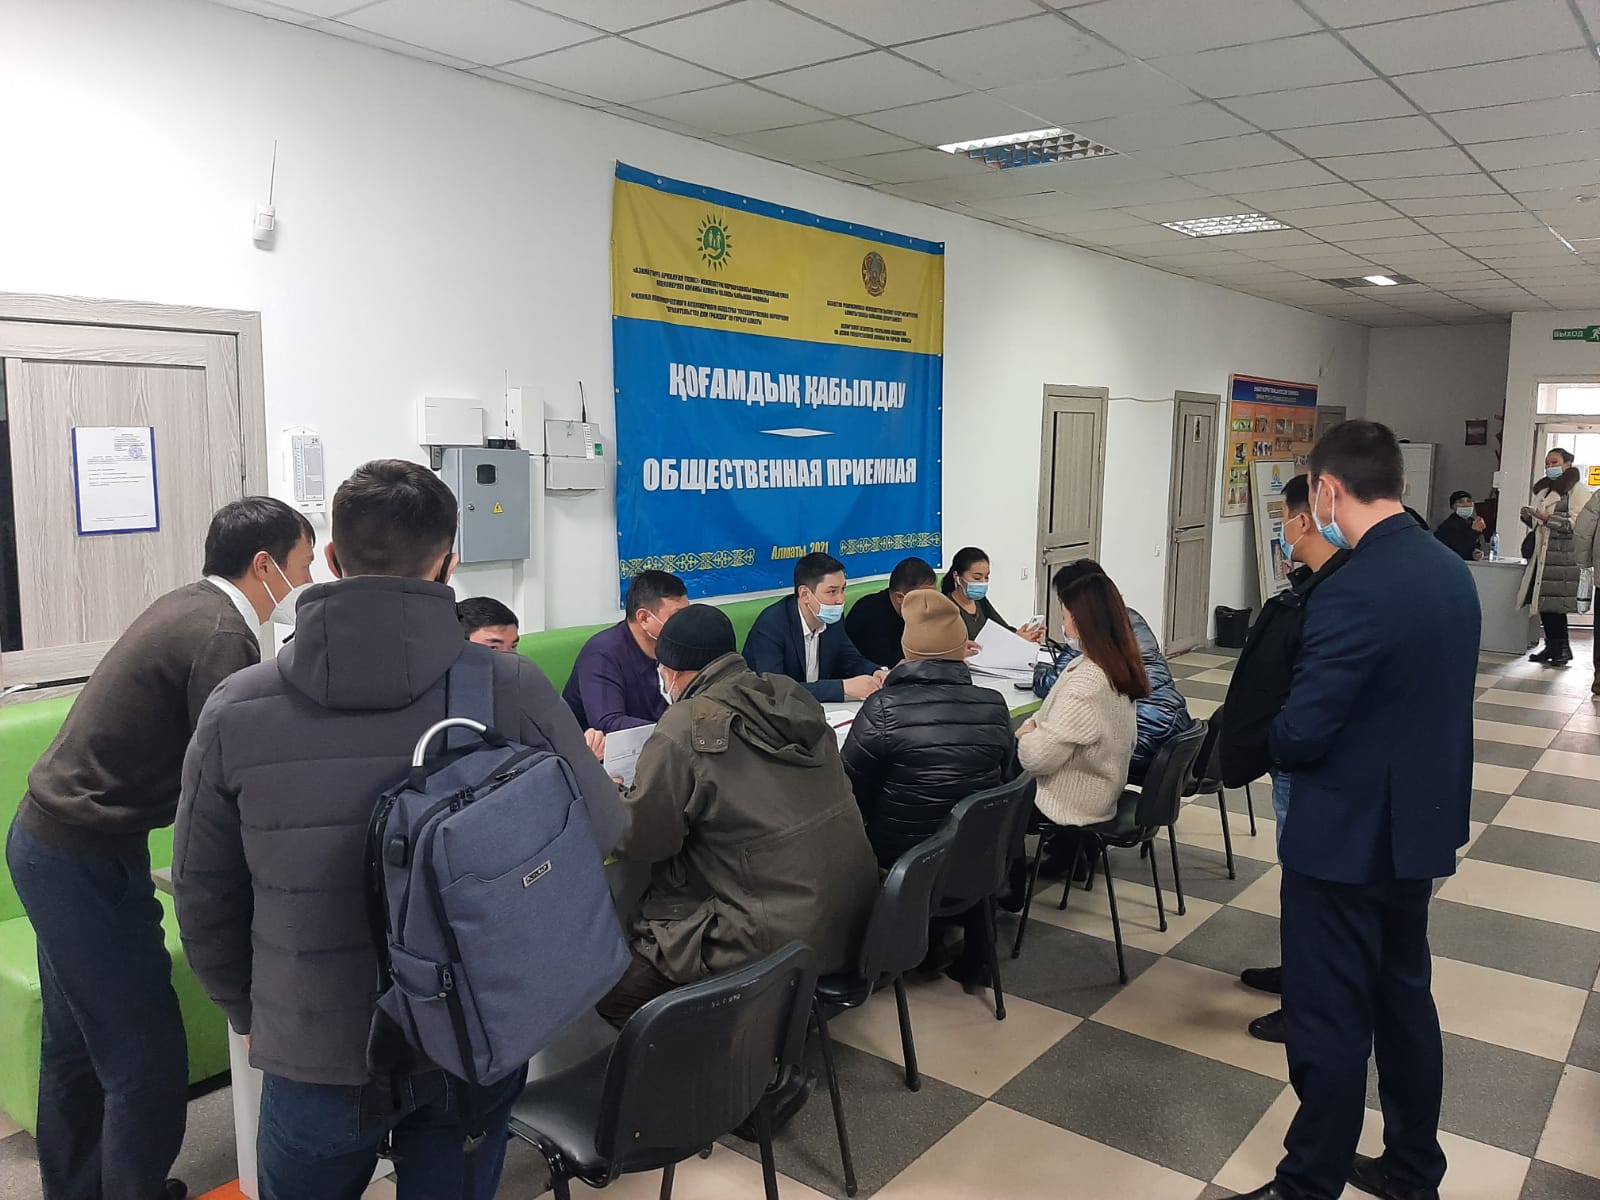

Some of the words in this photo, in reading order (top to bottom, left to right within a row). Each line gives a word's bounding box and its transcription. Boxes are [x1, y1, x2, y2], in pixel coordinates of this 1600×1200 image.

[1553, 330, 1584, 338] ВЫХОД
[669, 362, 801, 409] ҚОҒАМДЫҚ
[804, 374, 907, 412] ҚАБЫЛДАУ
[643, 457, 823, 495] ОБЩЕСТВЕННАЯ
[826, 457, 918, 487] ПРИЕМНАЯ
[810, 541, 829, 554] 2021
